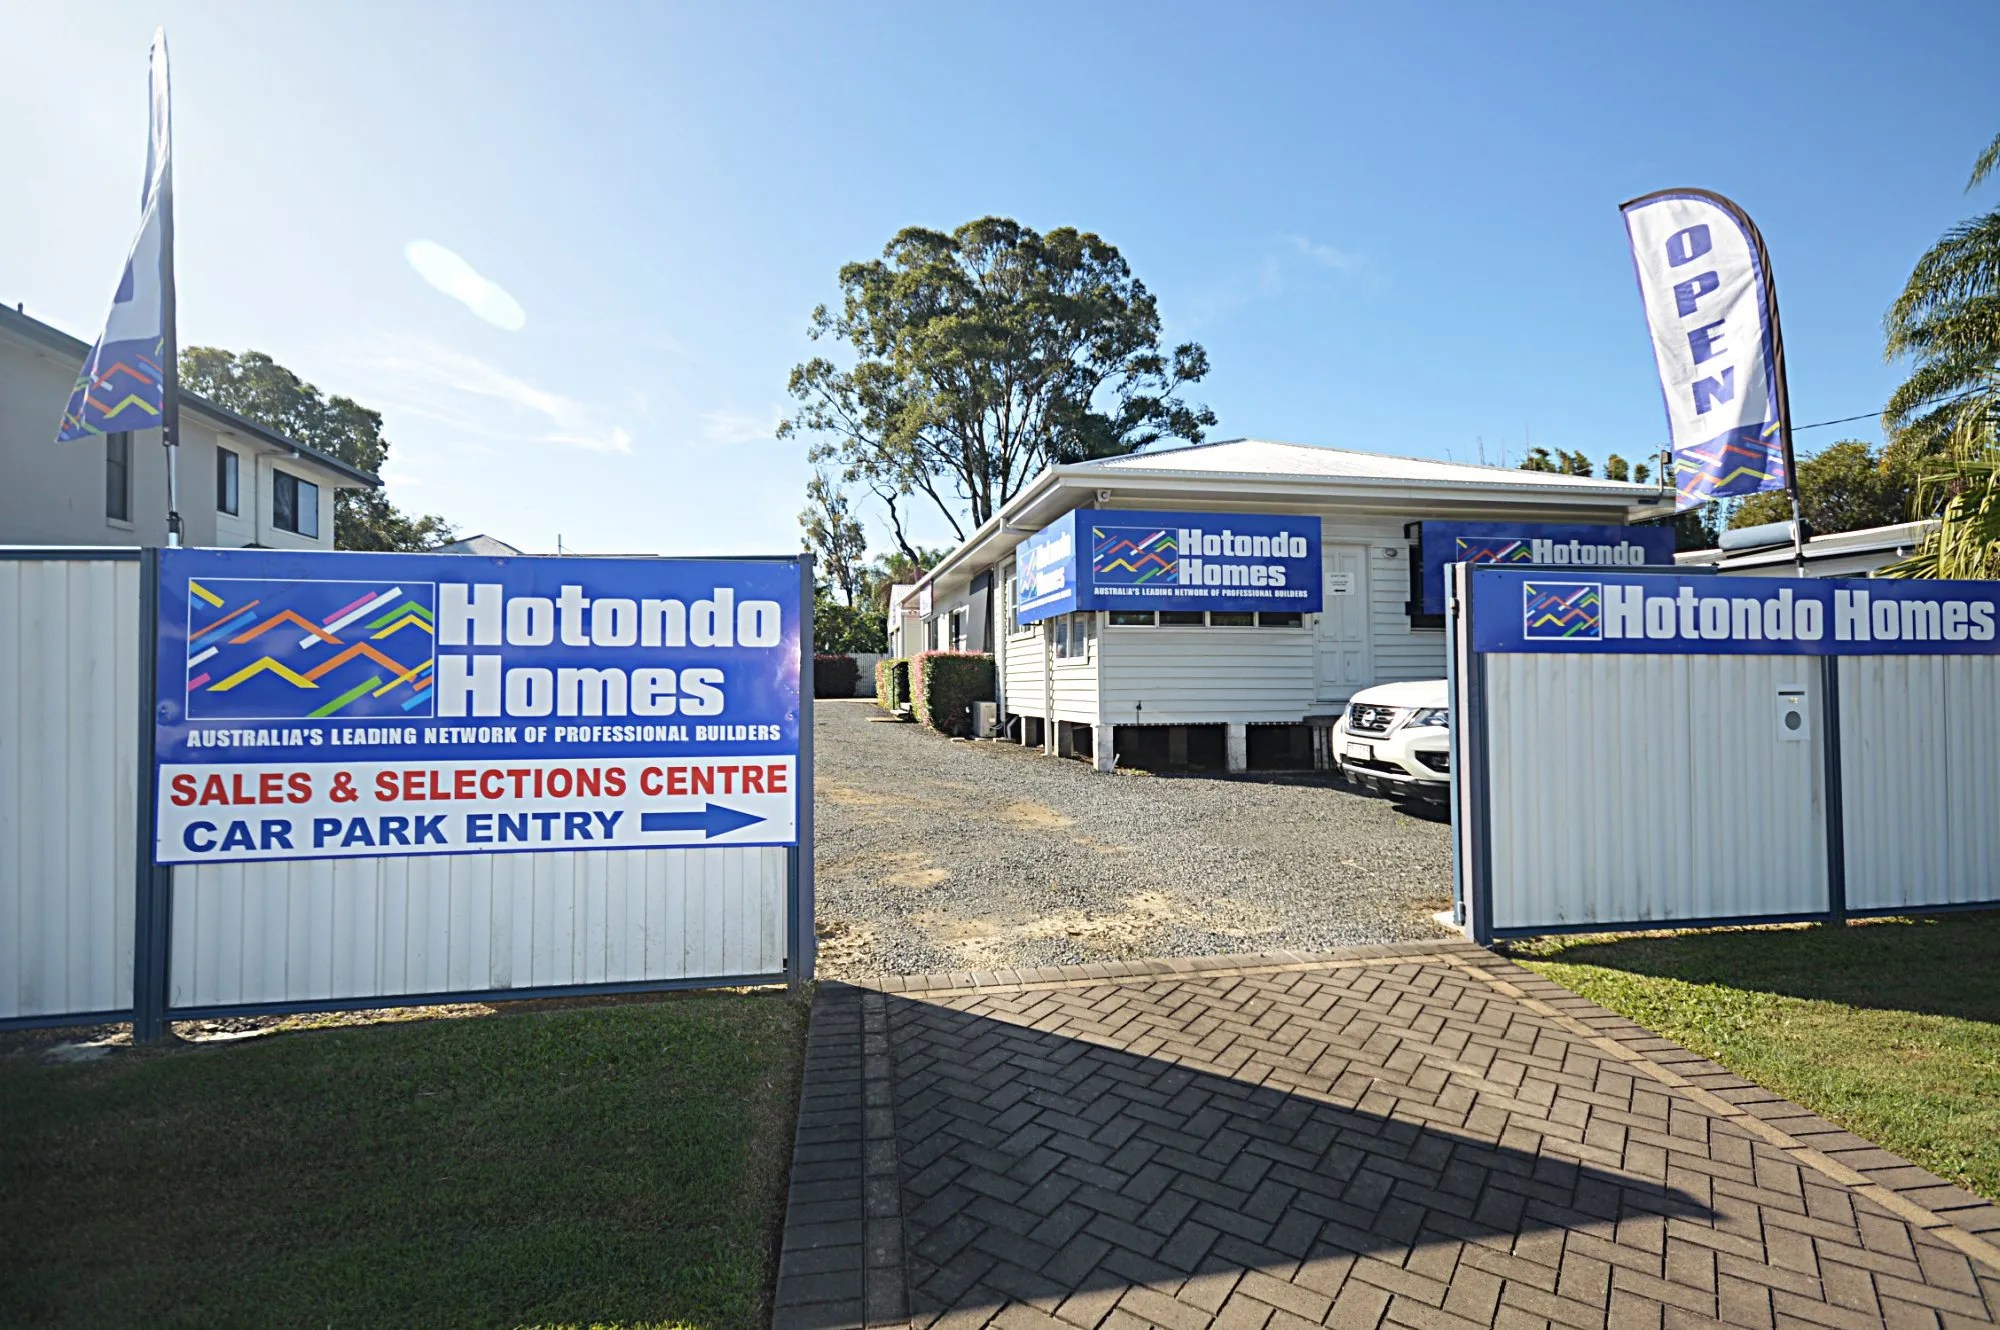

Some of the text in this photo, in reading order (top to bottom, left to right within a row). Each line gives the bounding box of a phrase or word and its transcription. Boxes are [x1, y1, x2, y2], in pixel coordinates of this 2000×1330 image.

[1665, 223, 1735, 416] OPEN
[1178, 528, 1307, 558] Hotondo
[1531, 538, 1646, 565] Hotondo
[1094, 587, 1309, 598] AUSTRALIA'S LEADING NETWORK OF PROFESSIONAL BUILDERS
[1178, 558, 1287, 587] Homes
[438, 583, 781, 648] Hotondo
[1603, 584, 1996, 641] Hotondo Homes
[437, 654, 725, 718] Homes
[186, 724, 782, 748] AUSTRALIA'S LEADING NETWORK OF PROFESSIONAL BUILDERS
[170, 764, 788, 807] SALES & SELECTIONS CENTRE
[182, 810, 625, 853] CAR PARK ENTRY
